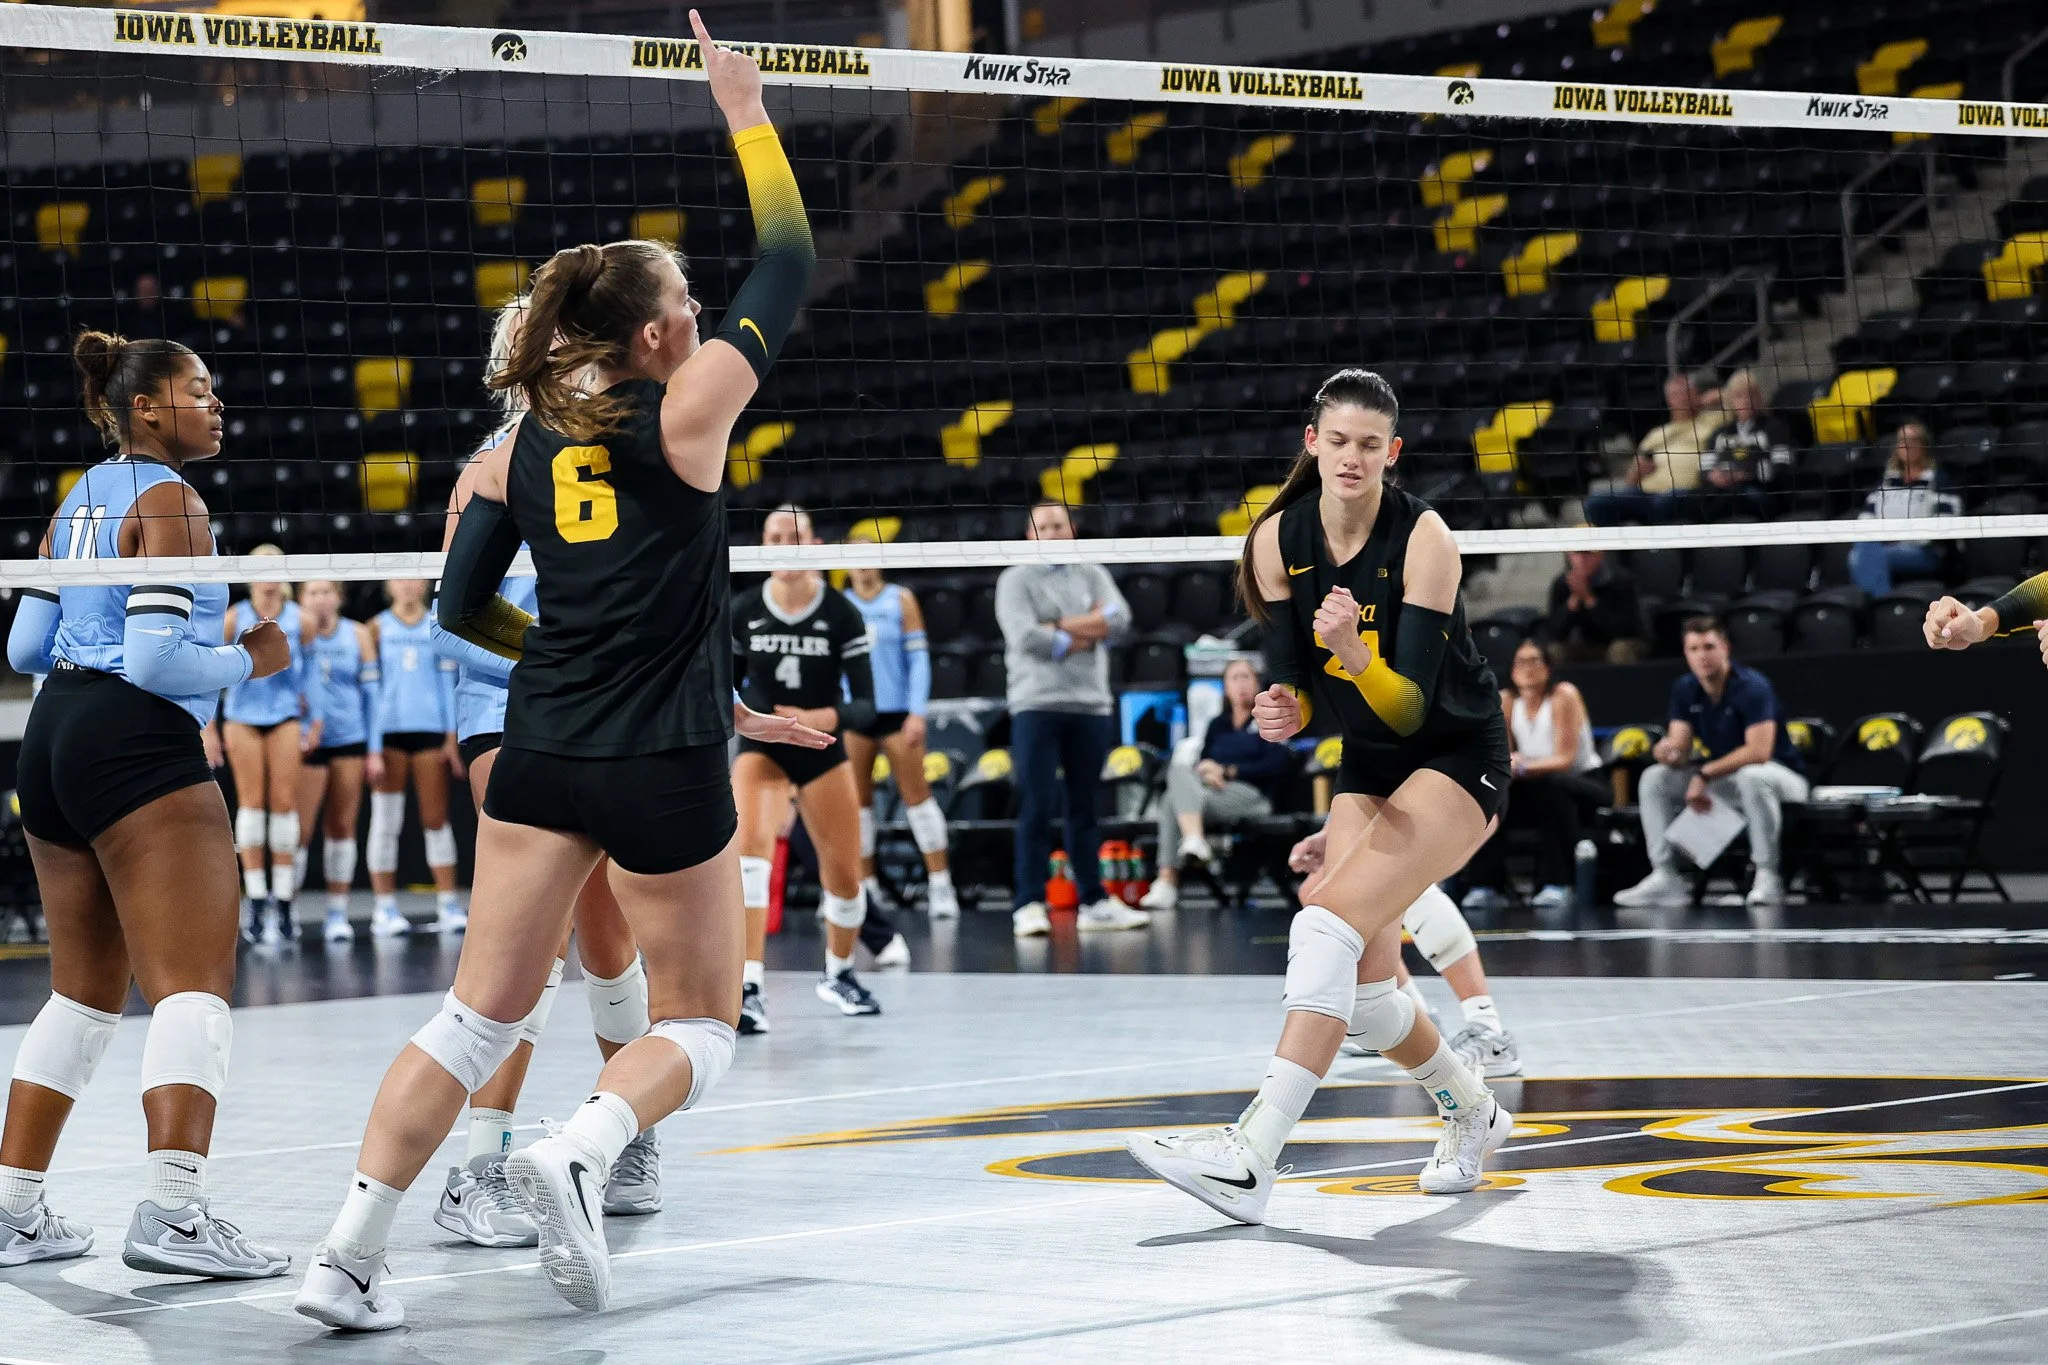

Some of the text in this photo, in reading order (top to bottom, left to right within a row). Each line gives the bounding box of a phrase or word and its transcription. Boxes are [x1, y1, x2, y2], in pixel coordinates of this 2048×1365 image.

[115, 12, 381, 54] IOWA VOLLEYBALL
[632, 40, 703, 69] IOWA
[1161, 66, 1363, 100] IOWA VOLLEYBALL
[1554, 86, 1733, 116] IOWA VOLLEYBALL
[1958, 103, 2005, 126] IOWA
[552, 444, 619, 544] 6
[67, 505, 106, 559] 11
[750, 633, 831, 656] BUTLER
[775, 655, 801, 690] 4
